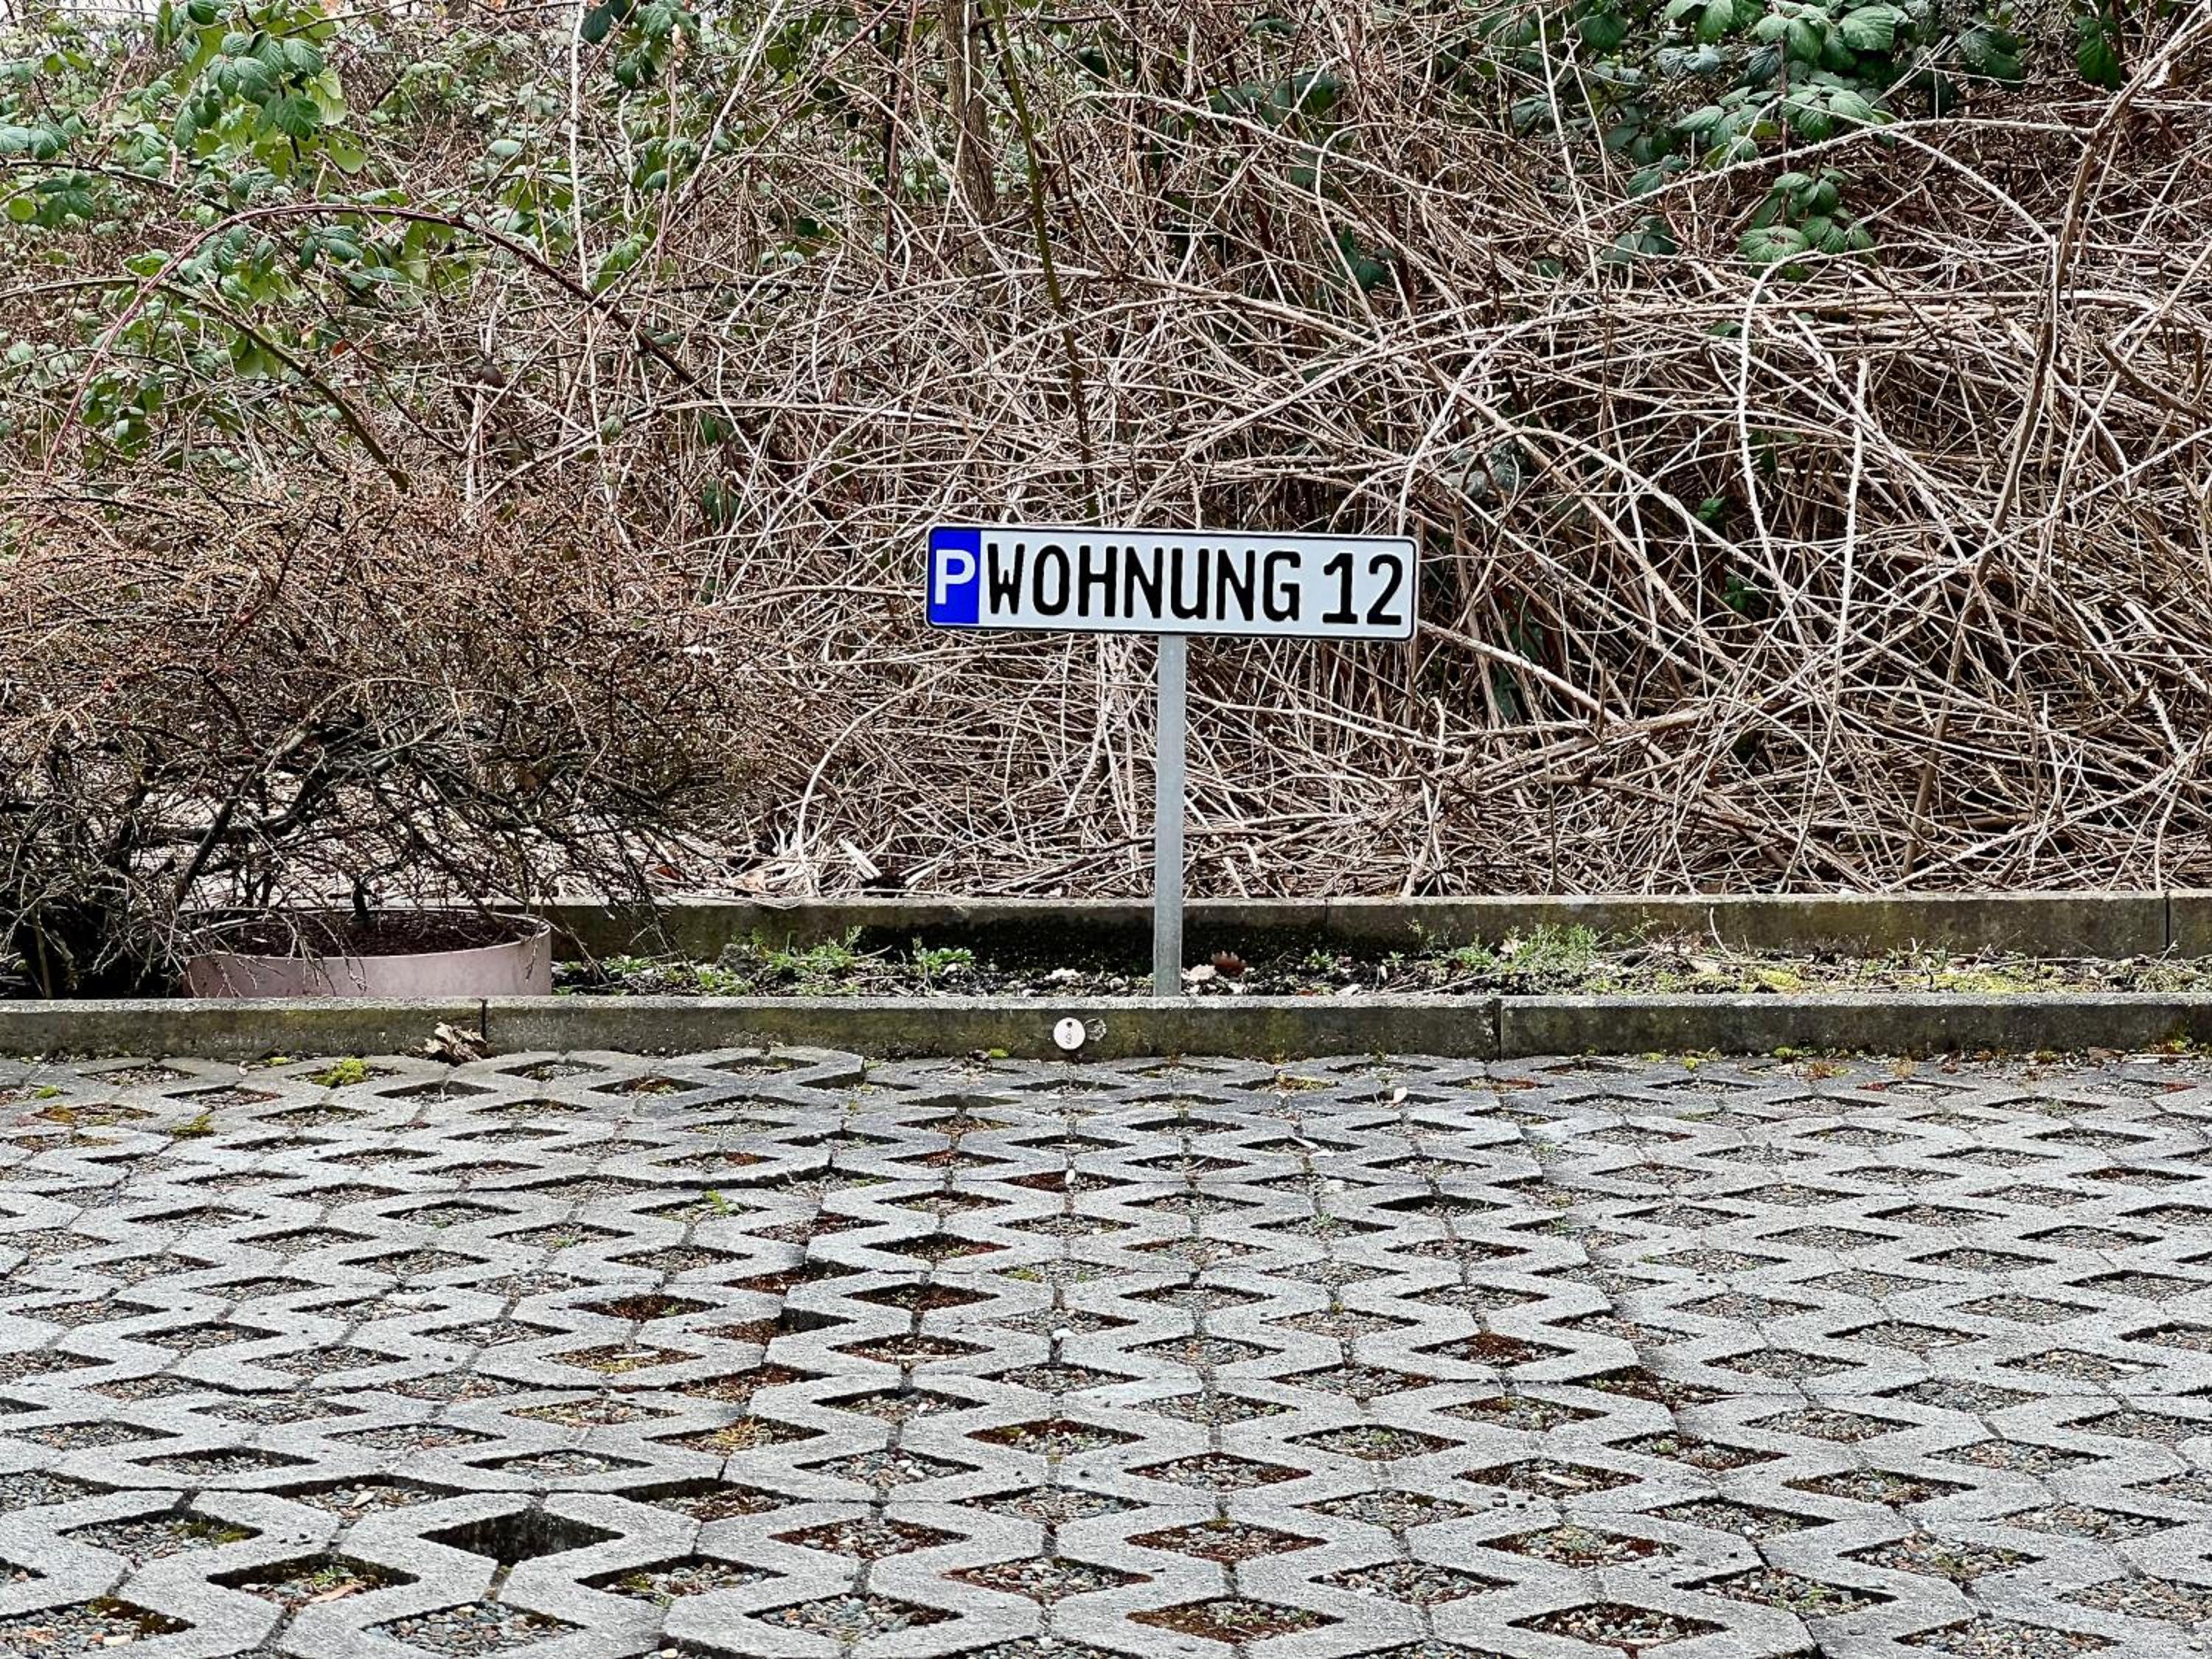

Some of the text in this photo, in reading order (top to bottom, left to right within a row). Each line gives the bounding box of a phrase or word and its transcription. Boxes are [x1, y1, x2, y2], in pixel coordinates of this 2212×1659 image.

[934, 543, 1403, 626] P WOHNUNG 12
